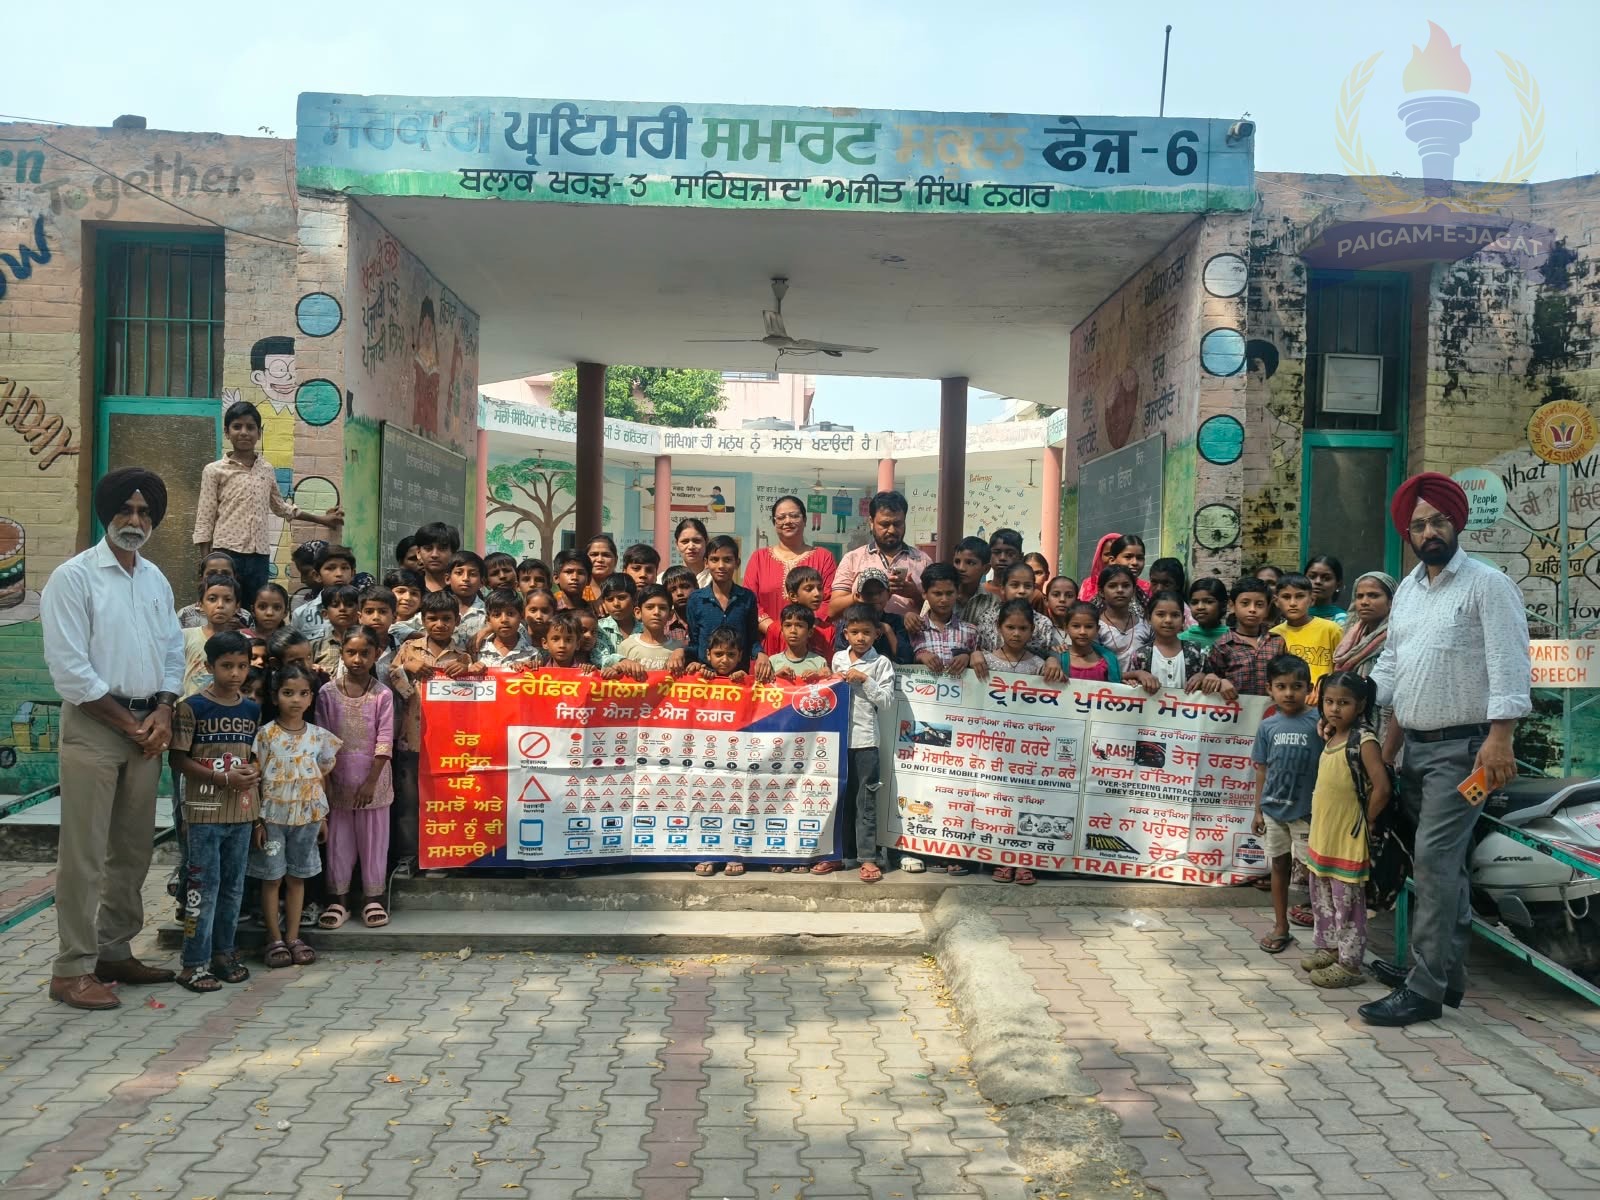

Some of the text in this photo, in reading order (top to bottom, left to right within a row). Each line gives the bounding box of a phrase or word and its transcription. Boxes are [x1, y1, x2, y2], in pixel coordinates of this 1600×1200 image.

[504, 102, 693, 166] ਪ੍ਰਾਇਮਰੀ
[701, 116, 882, 165] ਸਮਾਰਟ
[458, 168, 537, 194] ਬਲਾਕ
[671, 170, 812, 202] ਸਾਹਿਬਜ਼ਾਦਾ
[822, 173, 906, 205] ਅਜੀਤ
[915, 175, 973, 206] ਸਿੰਘ
[983, 183, 1054, 208] ਨਗਰ
[1473, 494, 1498, 505] People
[1529, 646, 1595, 661] PARTS OF
[1531, 667, 1587, 683] SPEECH
[1073, 687, 1147, 713] ਪੁਲਿਸ
[1157, 692, 1243, 724] ਮੋਹਾਲੀ
[695, 708, 736, 723] ਨਗਰ
[197, 717, 256, 734] RUGGED
[453, 729, 481, 746] ਰੋਡ
[956, 729, 1051, 757] ਡਰਾਇਵਿੰਗ ਕਰਦੇ
[1273, 733, 1308, 746] SURFER'S
[1106, 743, 1135, 758] RASH
[440, 753, 492, 769] ਸਾਇਨ
[990, 757, 1004, 772] ਦੀ
[1041, 765, 1055, 778] ਨਾ
[1058, 763, 1077, 780] ਕਰੋ
[901, 762, 1072, 789] DO NOT USE MOBILE PHONE WHILE DRIVING
[1091, 766, 1134, 780] ਆਤਮ
[1198, 774, 1215, 788] ਦੀ
[1097, 780, 1255, 800] OVER-SPEEDING ATTRACTS ONLY SUICID
[1105, 788, 1127, 796] OBEY
[1128, 790, 1157, 799] SPEED
[1158, 793, 1180, 802] LIMIT
[1182, 796, 1197, 804] FOR
[1199, 797, 1221, 805] YOUR
[425, 796, 503, 812] ਸਮਝੋ ਅਤੇ
[425, 818, 504, 840] ਹੋਰਾਂ ਨੂੰ ਵੀ
[971, 818, 1016, 836] ਤਿਆਗੋ
[1088, 812, 1112, 830] ਕਦੇ
[1119, 818, 1136, 832] ਨਾ
[1195, 824, 1229, 842] ਨਾਲੋਂ
[980, 833, 993, 845] ਦੀ
[1037, 839, 1056, 851] ਕਰੋ
[894, 835, 993, 861] ALWAYS
[1000, 851, 1066, 870] OBEY
[1072, 857, 1175, 879] TRAFFIC
[1148, 842, 1180, 861] ਦੇਰ
[1187, 848, 1225, 867] ਭਲੀ
